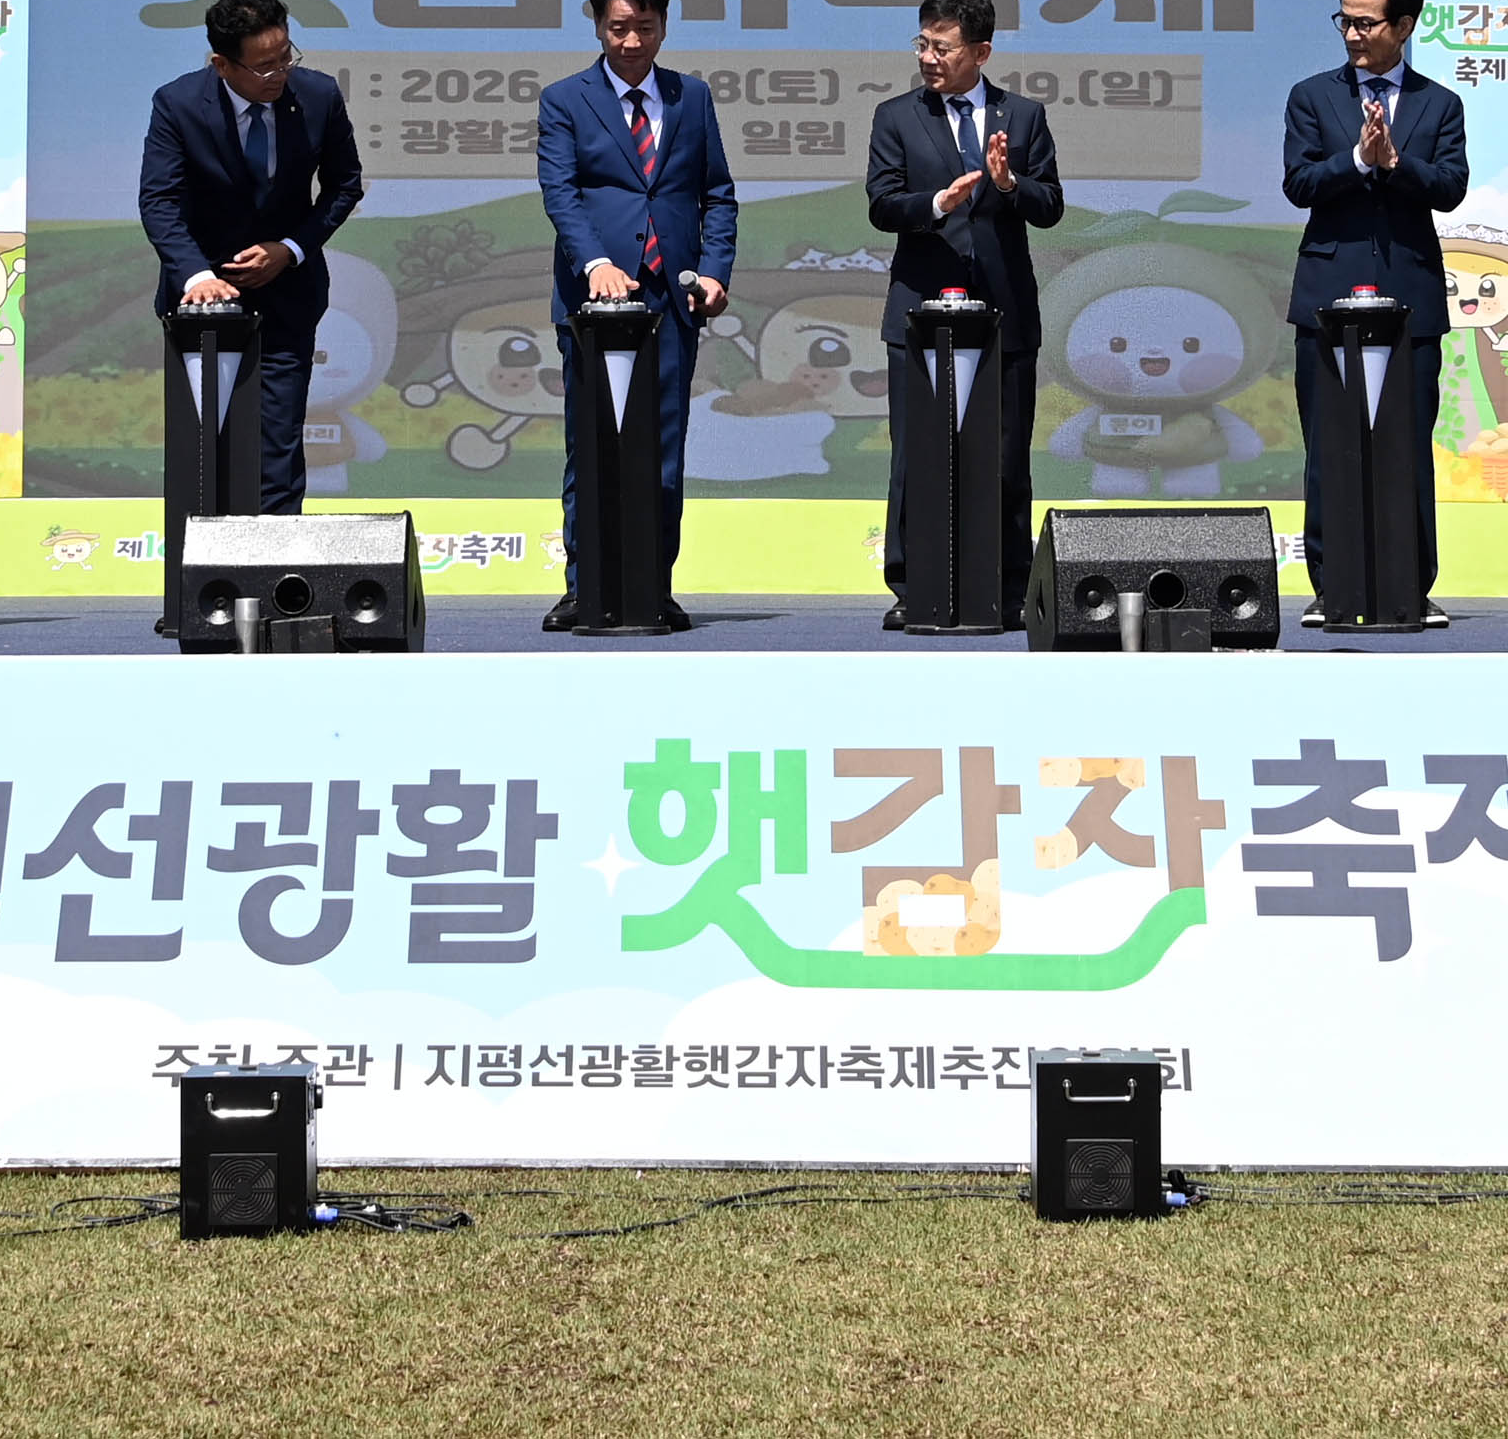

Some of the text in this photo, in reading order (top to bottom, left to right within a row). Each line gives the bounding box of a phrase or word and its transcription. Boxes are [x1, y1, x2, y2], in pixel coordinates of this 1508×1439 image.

[692, 68, 840, 105] 8(토)
[1455, 56, 1507, 87] 축제
[742, 120, 846, 155] 일원
[415, 534, 522, 570] 자축제
[424, 1043, 1192, 1091] 지평선광활햇감자축제추진회
